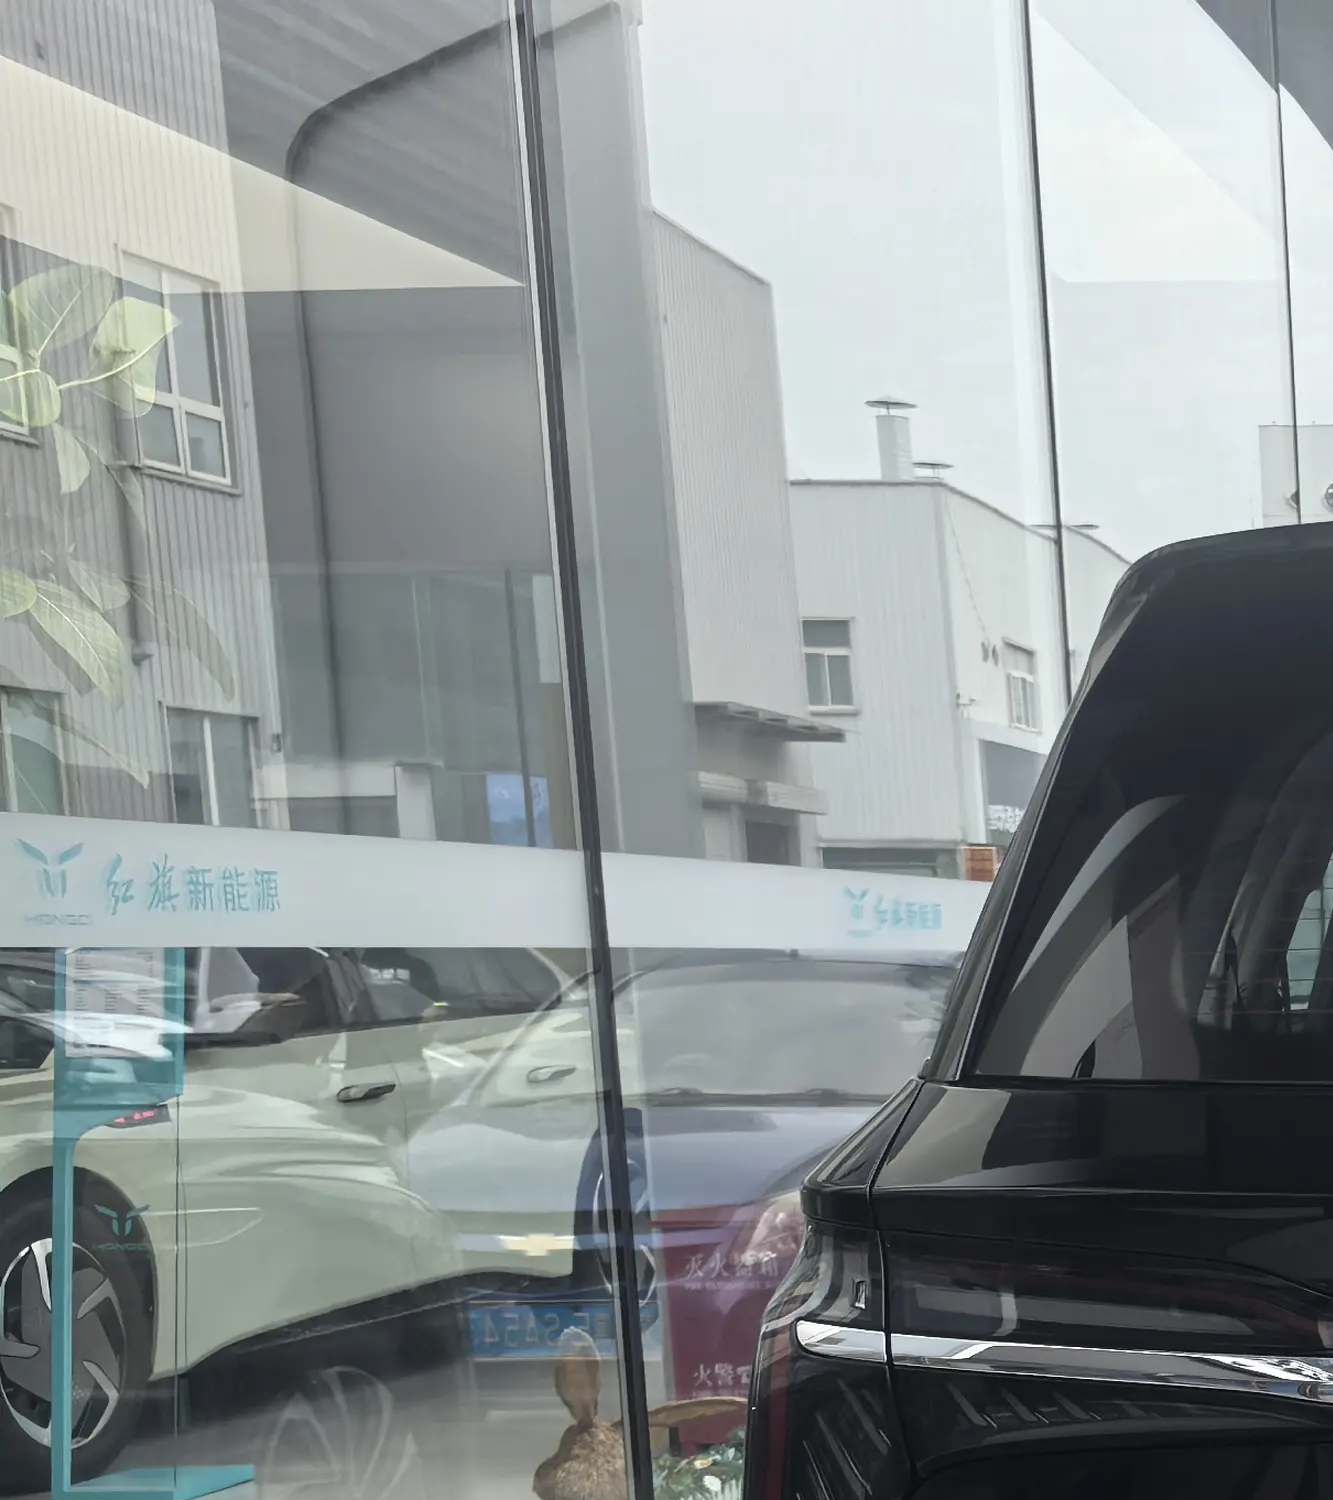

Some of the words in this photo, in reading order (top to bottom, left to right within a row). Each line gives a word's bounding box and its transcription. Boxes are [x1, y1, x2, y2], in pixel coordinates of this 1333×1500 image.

[104, 853, 281, 915] 红旗新能源
